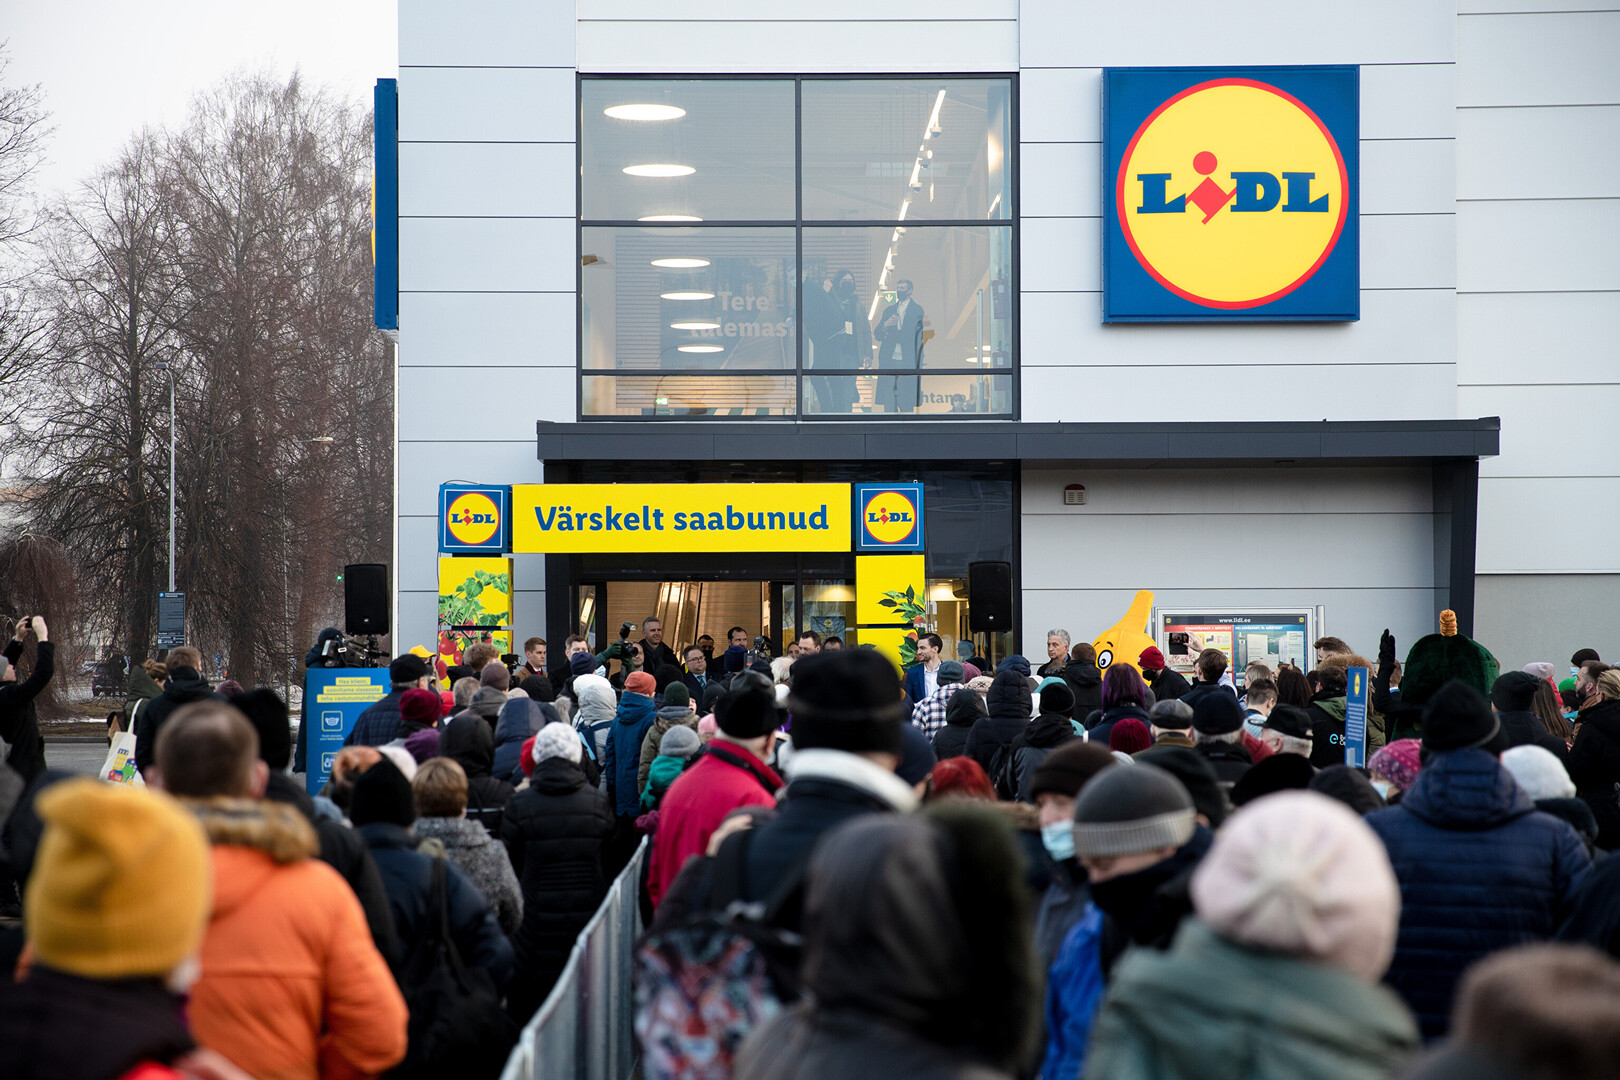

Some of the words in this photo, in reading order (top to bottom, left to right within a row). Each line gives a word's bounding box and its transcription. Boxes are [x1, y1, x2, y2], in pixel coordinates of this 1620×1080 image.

[717, 291, 769, 311] Tere
[534, 505, 664, 531] Värskelt
[673, 504, 829, 531] saabunud
